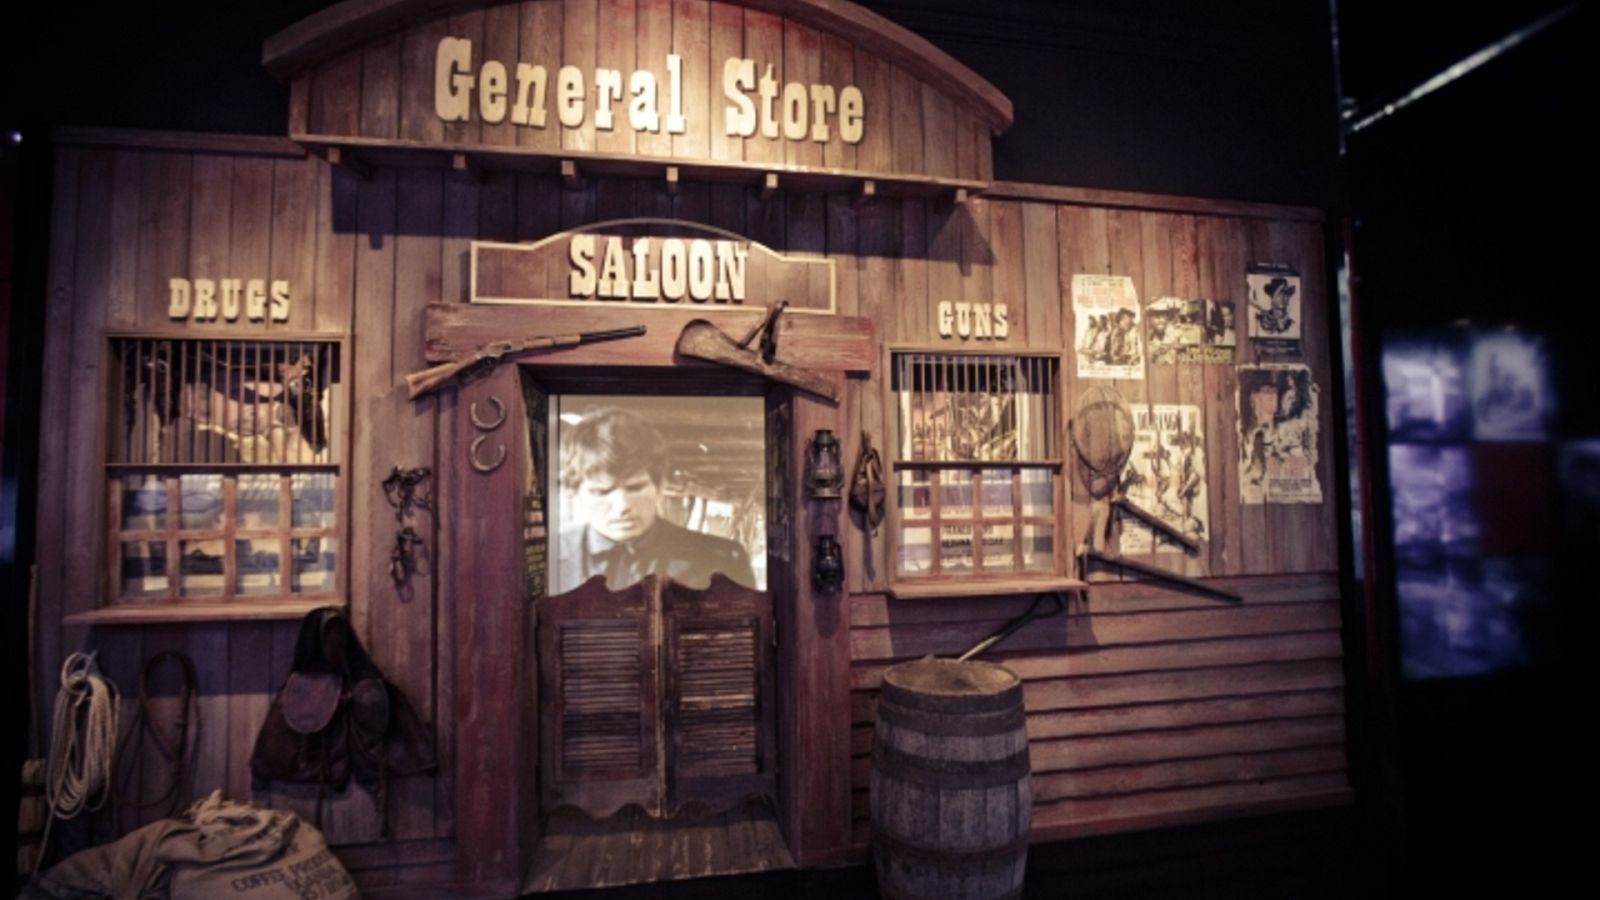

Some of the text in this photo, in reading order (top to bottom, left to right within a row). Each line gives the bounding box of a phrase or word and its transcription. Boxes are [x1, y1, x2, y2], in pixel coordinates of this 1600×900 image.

[434, 36, 865, 144] General Store
[569, 234, 749, 302] SALOON
[168, 278, 291, 321] DRUGS
[938, 300, 1009, 339] GUNS
